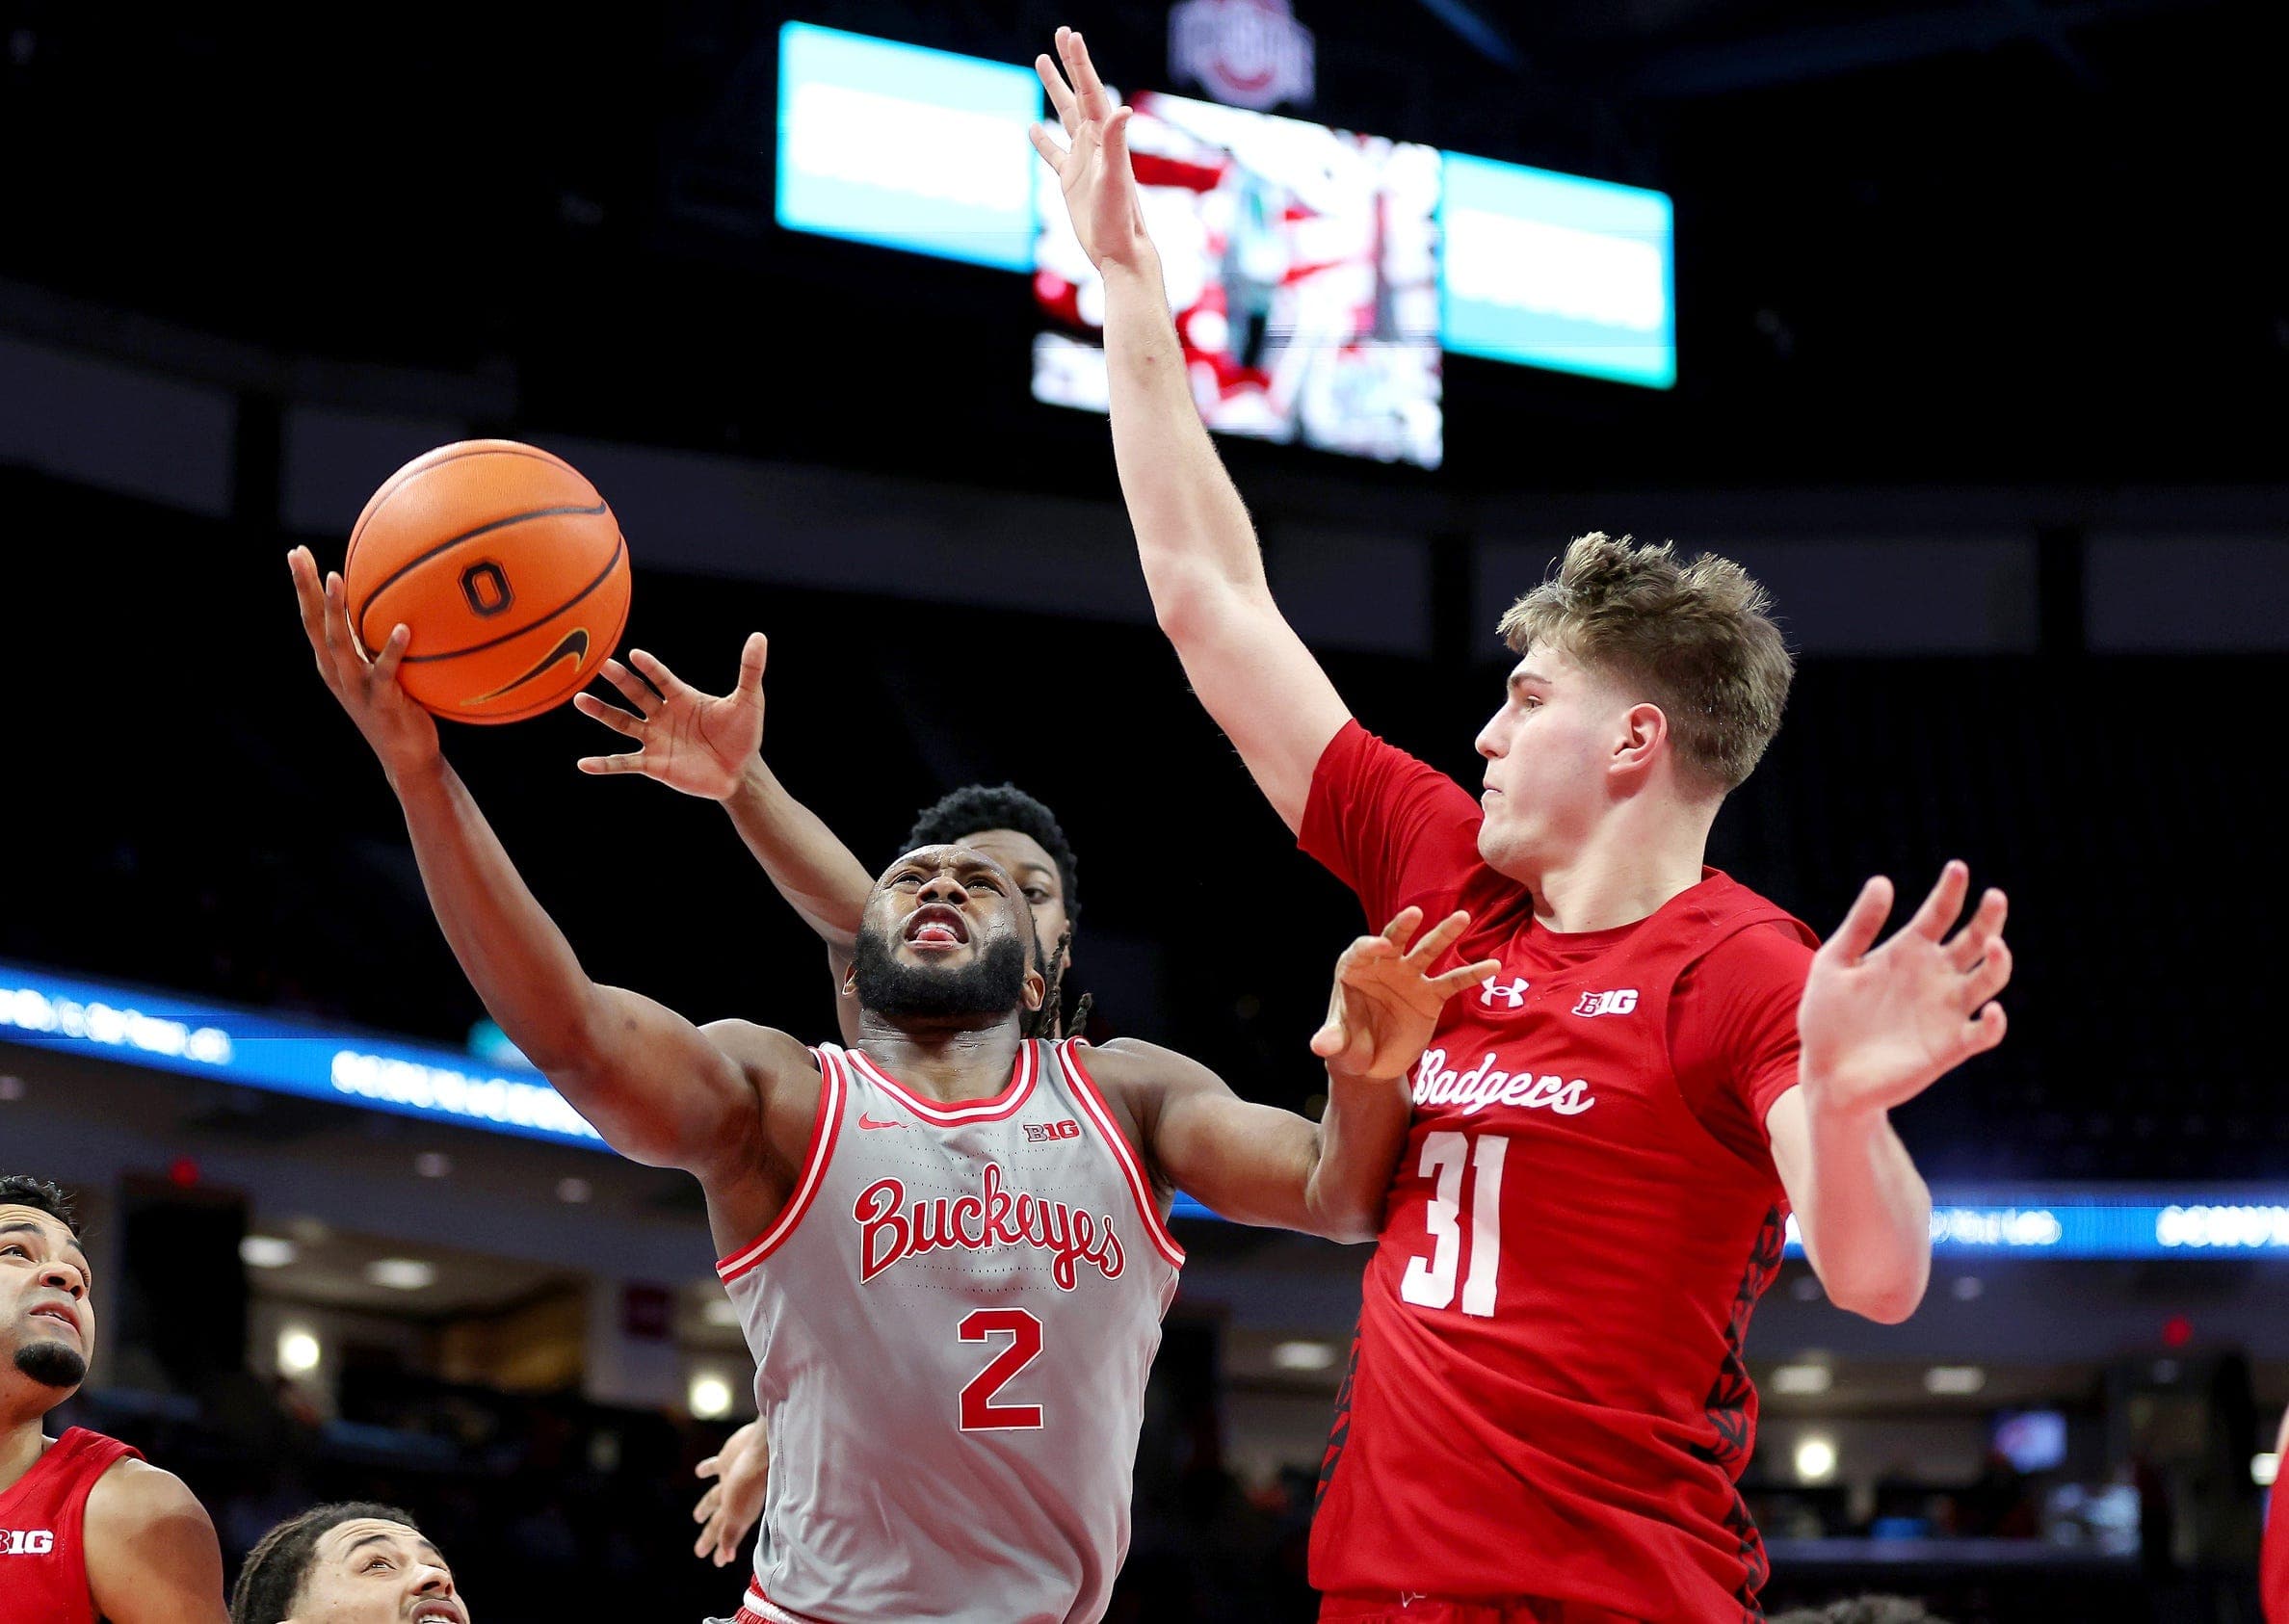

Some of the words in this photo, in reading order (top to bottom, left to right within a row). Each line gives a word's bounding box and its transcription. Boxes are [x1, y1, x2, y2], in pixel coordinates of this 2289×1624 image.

[1412, 1048, 1595, 1115] Badgers
[853, 1162, 1125, 1292] Buckeyes
[1400, 1131, 1510, 1317] 31
[957, 1307, 1043, 1431] 2
